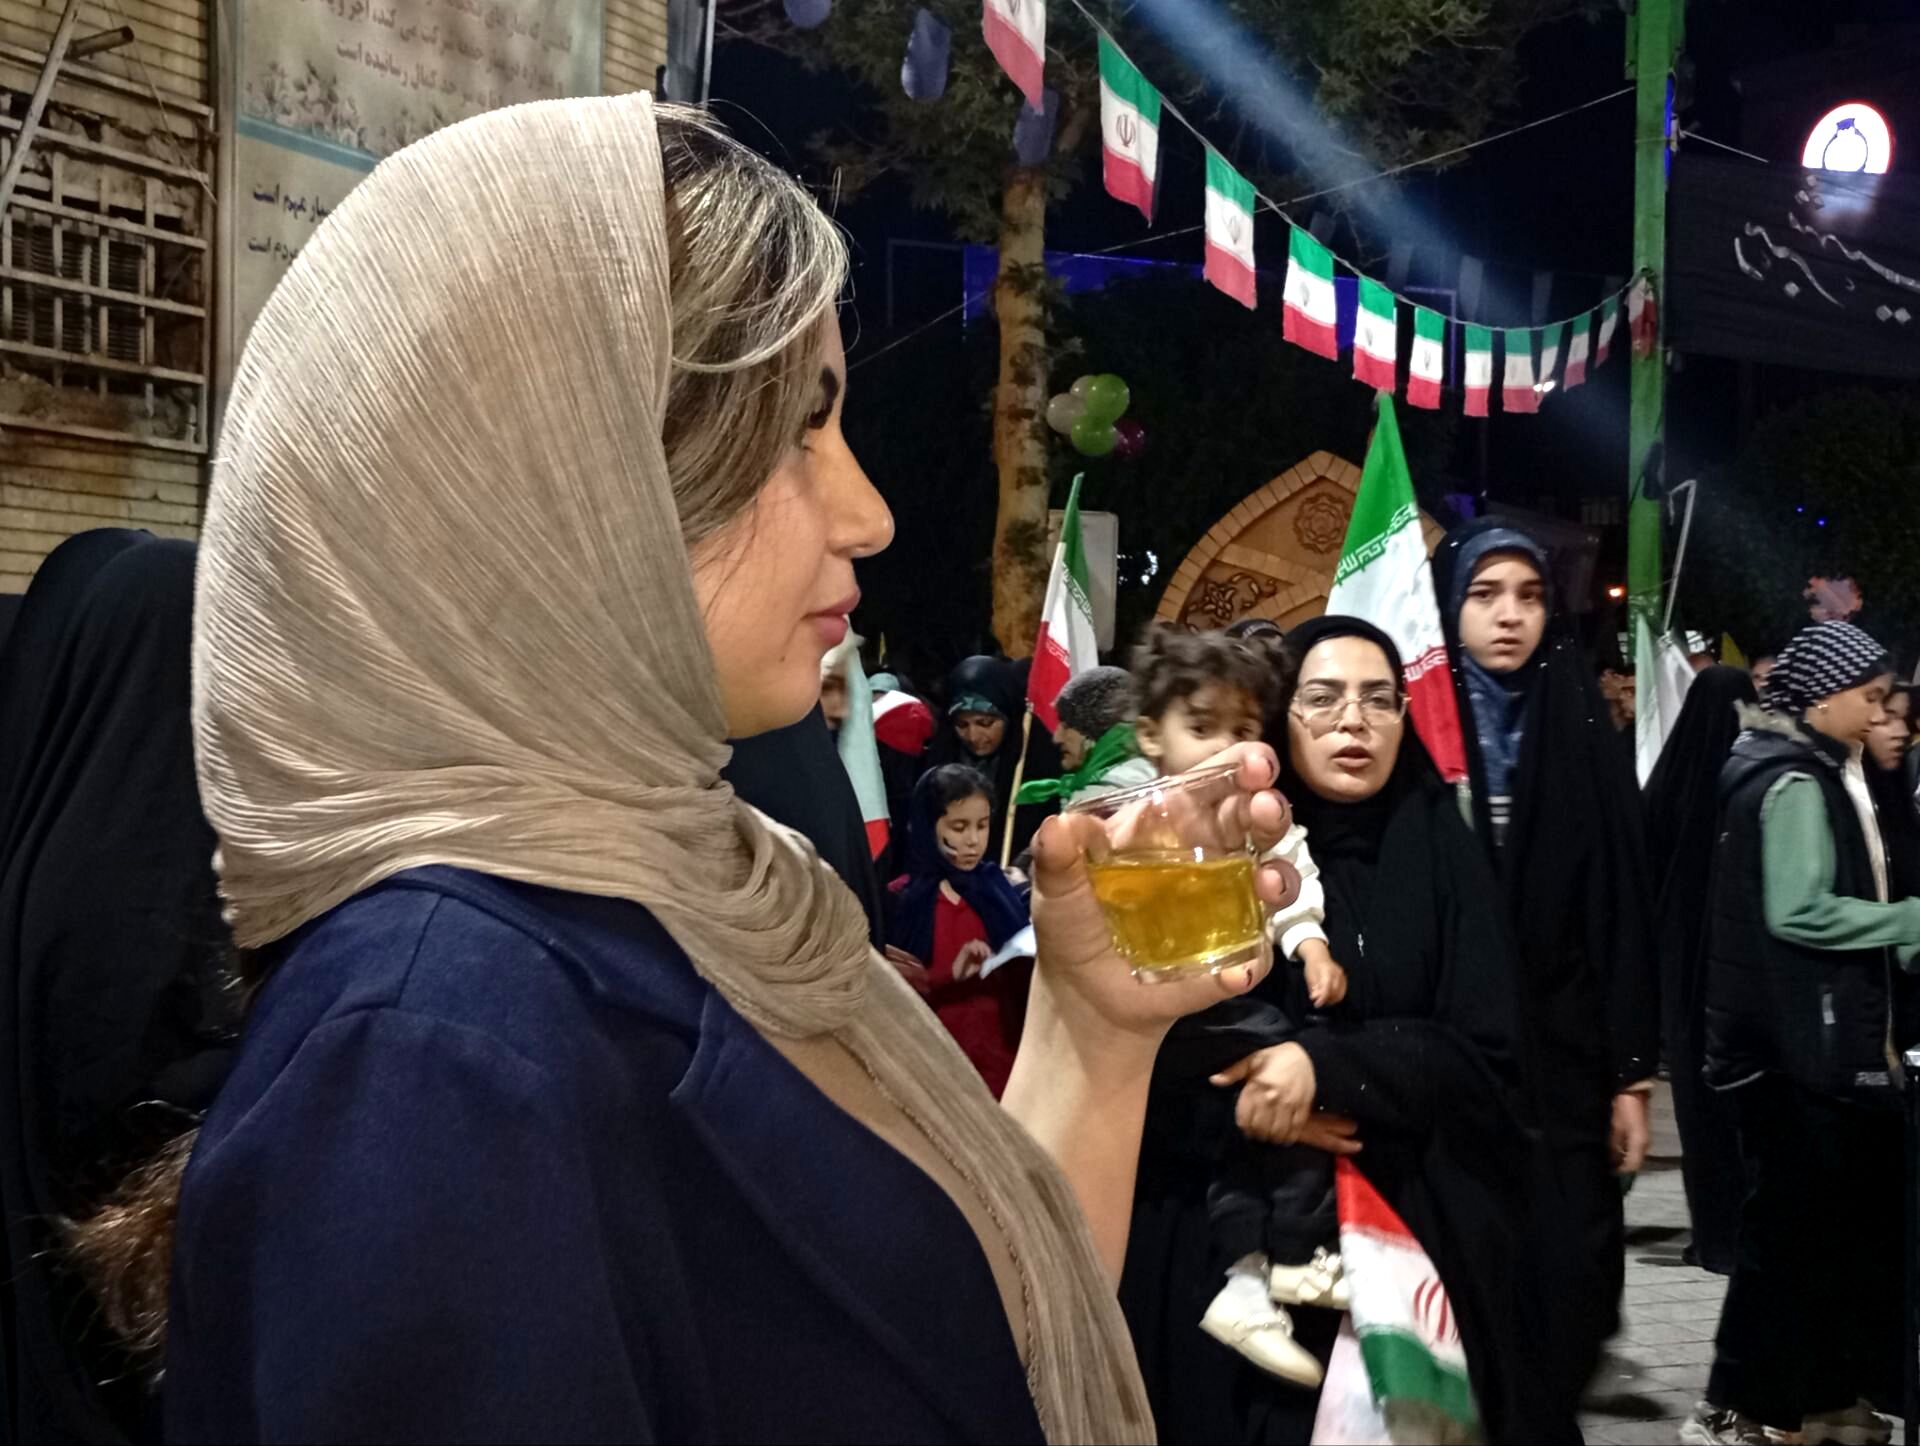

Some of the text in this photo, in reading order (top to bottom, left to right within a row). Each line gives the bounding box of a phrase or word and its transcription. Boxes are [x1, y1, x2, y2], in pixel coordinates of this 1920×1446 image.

[336, 40, 362, 62] است
[253, 183, 280, 206] است
[248, 236, 271, 254] است
